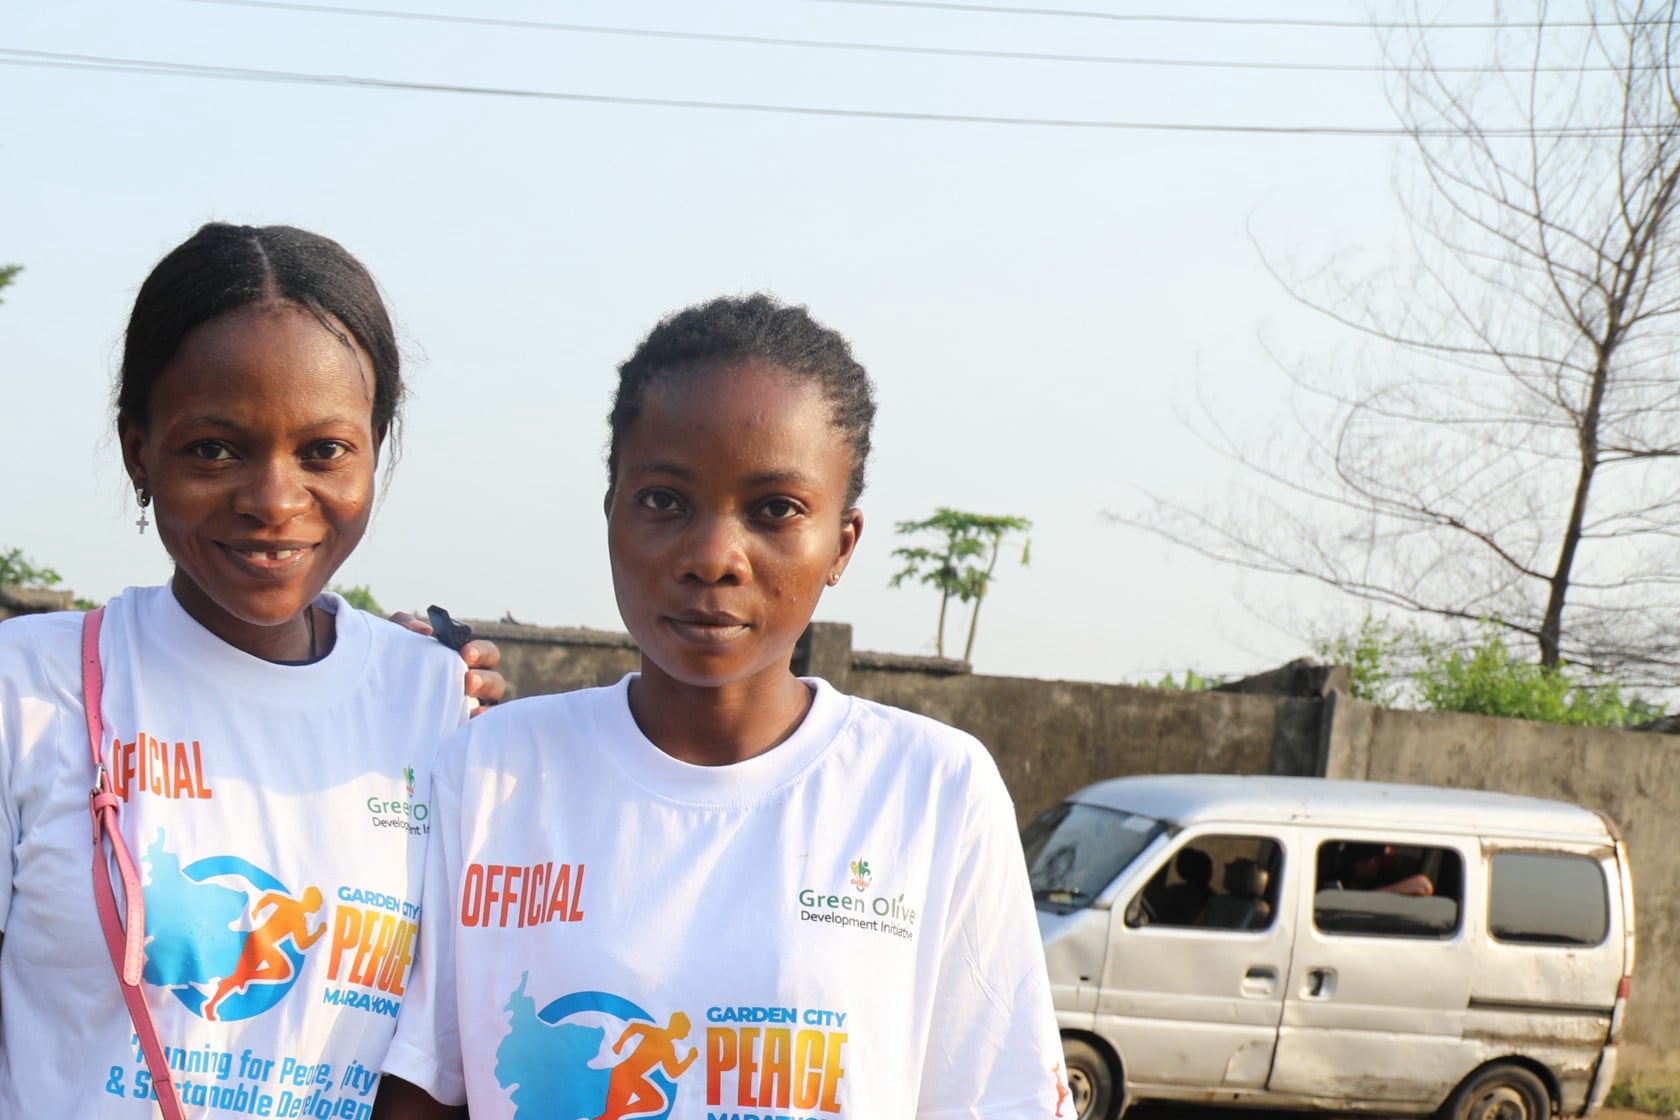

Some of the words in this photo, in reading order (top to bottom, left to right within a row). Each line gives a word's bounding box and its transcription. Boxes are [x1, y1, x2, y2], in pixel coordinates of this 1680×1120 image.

[113, 732, 213, 804] OFICIAL
[367, 796, 412, 816] Gree
[337, 886, 400, 912] GARDEN
[461, 862, 585, 928] OFFICIAL
[799, 889, 865, 914] Green
[872, 893, 916, 925] Olive
[801, 910, 878, 931] Development
[327, 905, 418, 997] PEACE
[323, 987, 400, 1018] MRAON
[706, 1006, 798, 1023] GARDEN
[803, 1009, 848, 1027] CITY
[131, 1033, 233, 1080] 'nning
[239, 1049, 275, 1082] for
[279, 1057, 333, 1092] Peae,
[340, 1059, 378, 1096] ity
[706, 1026, 849, 1114] PEACE
[106, 1065, 125, 1098] &
[133, 1070, 273, 1117] Stanable
